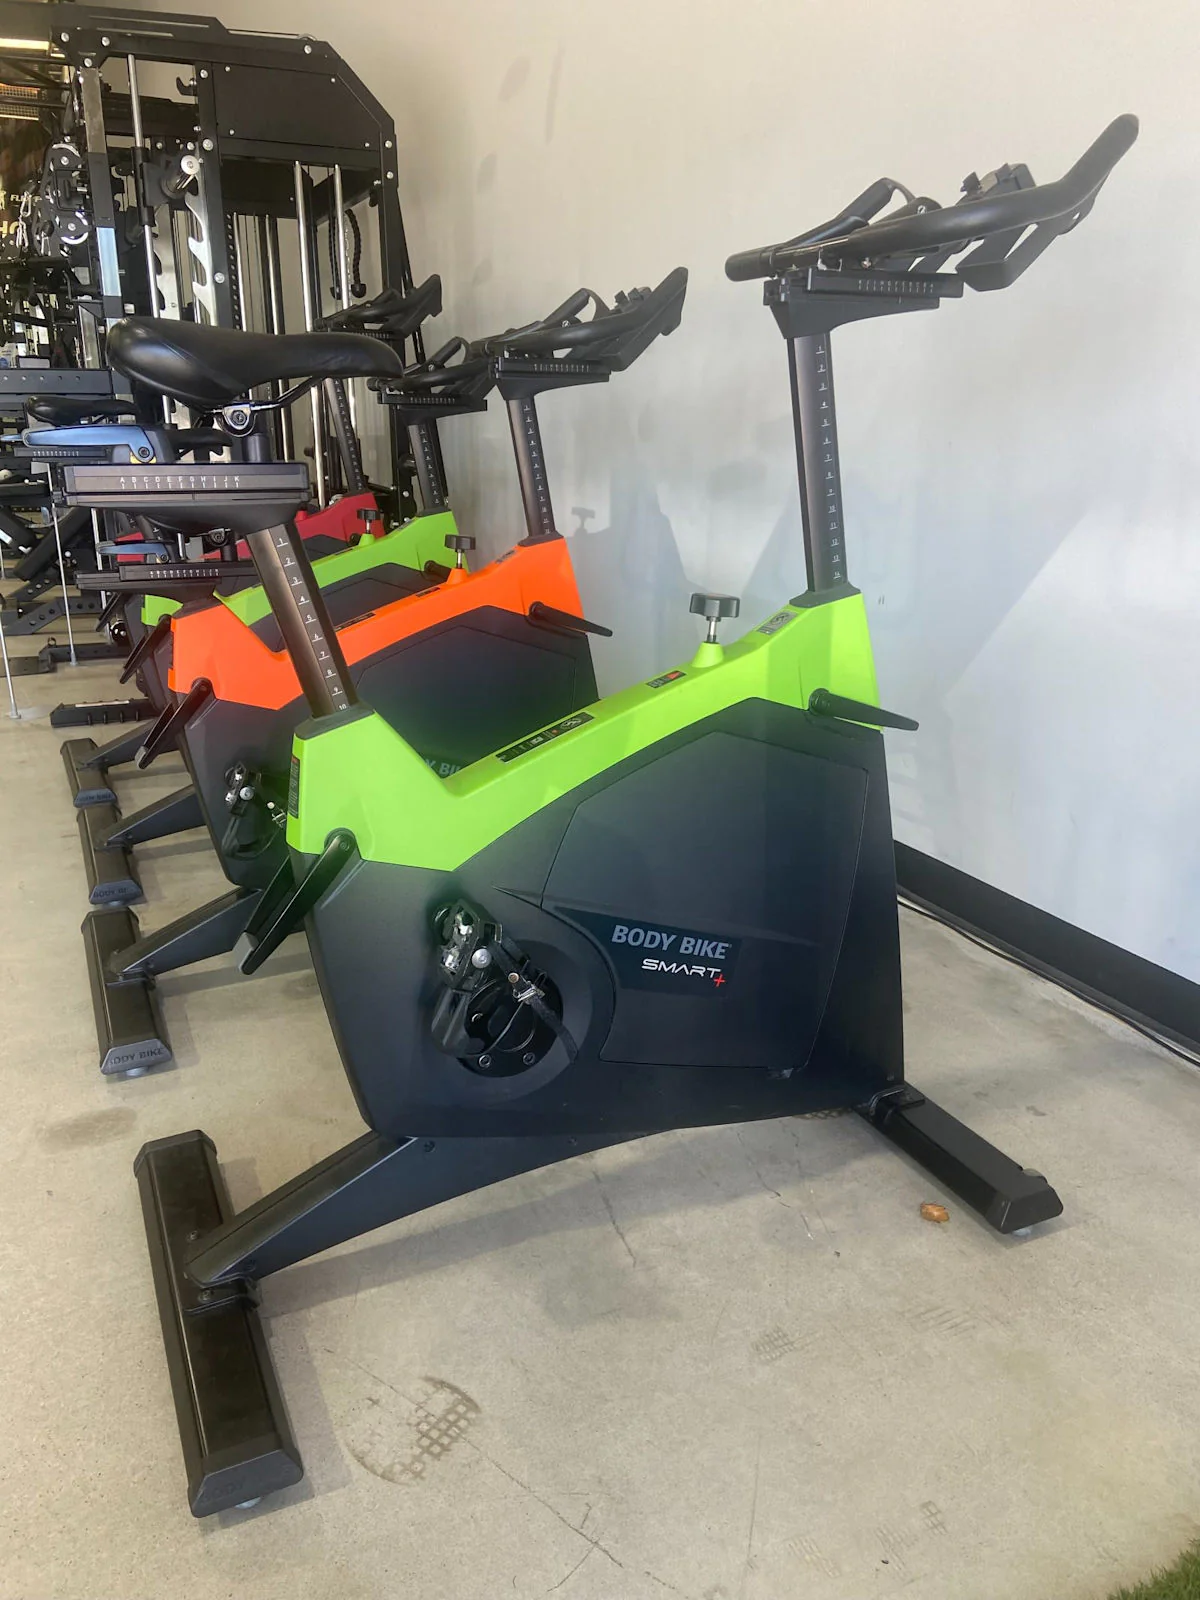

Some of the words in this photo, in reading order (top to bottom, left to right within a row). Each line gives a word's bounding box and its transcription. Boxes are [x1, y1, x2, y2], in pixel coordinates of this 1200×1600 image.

[611, 924, 676, 951] BODY
[679, 936, 729, 959] BIKE
[139, 1047, 164, 1060] BIKE
